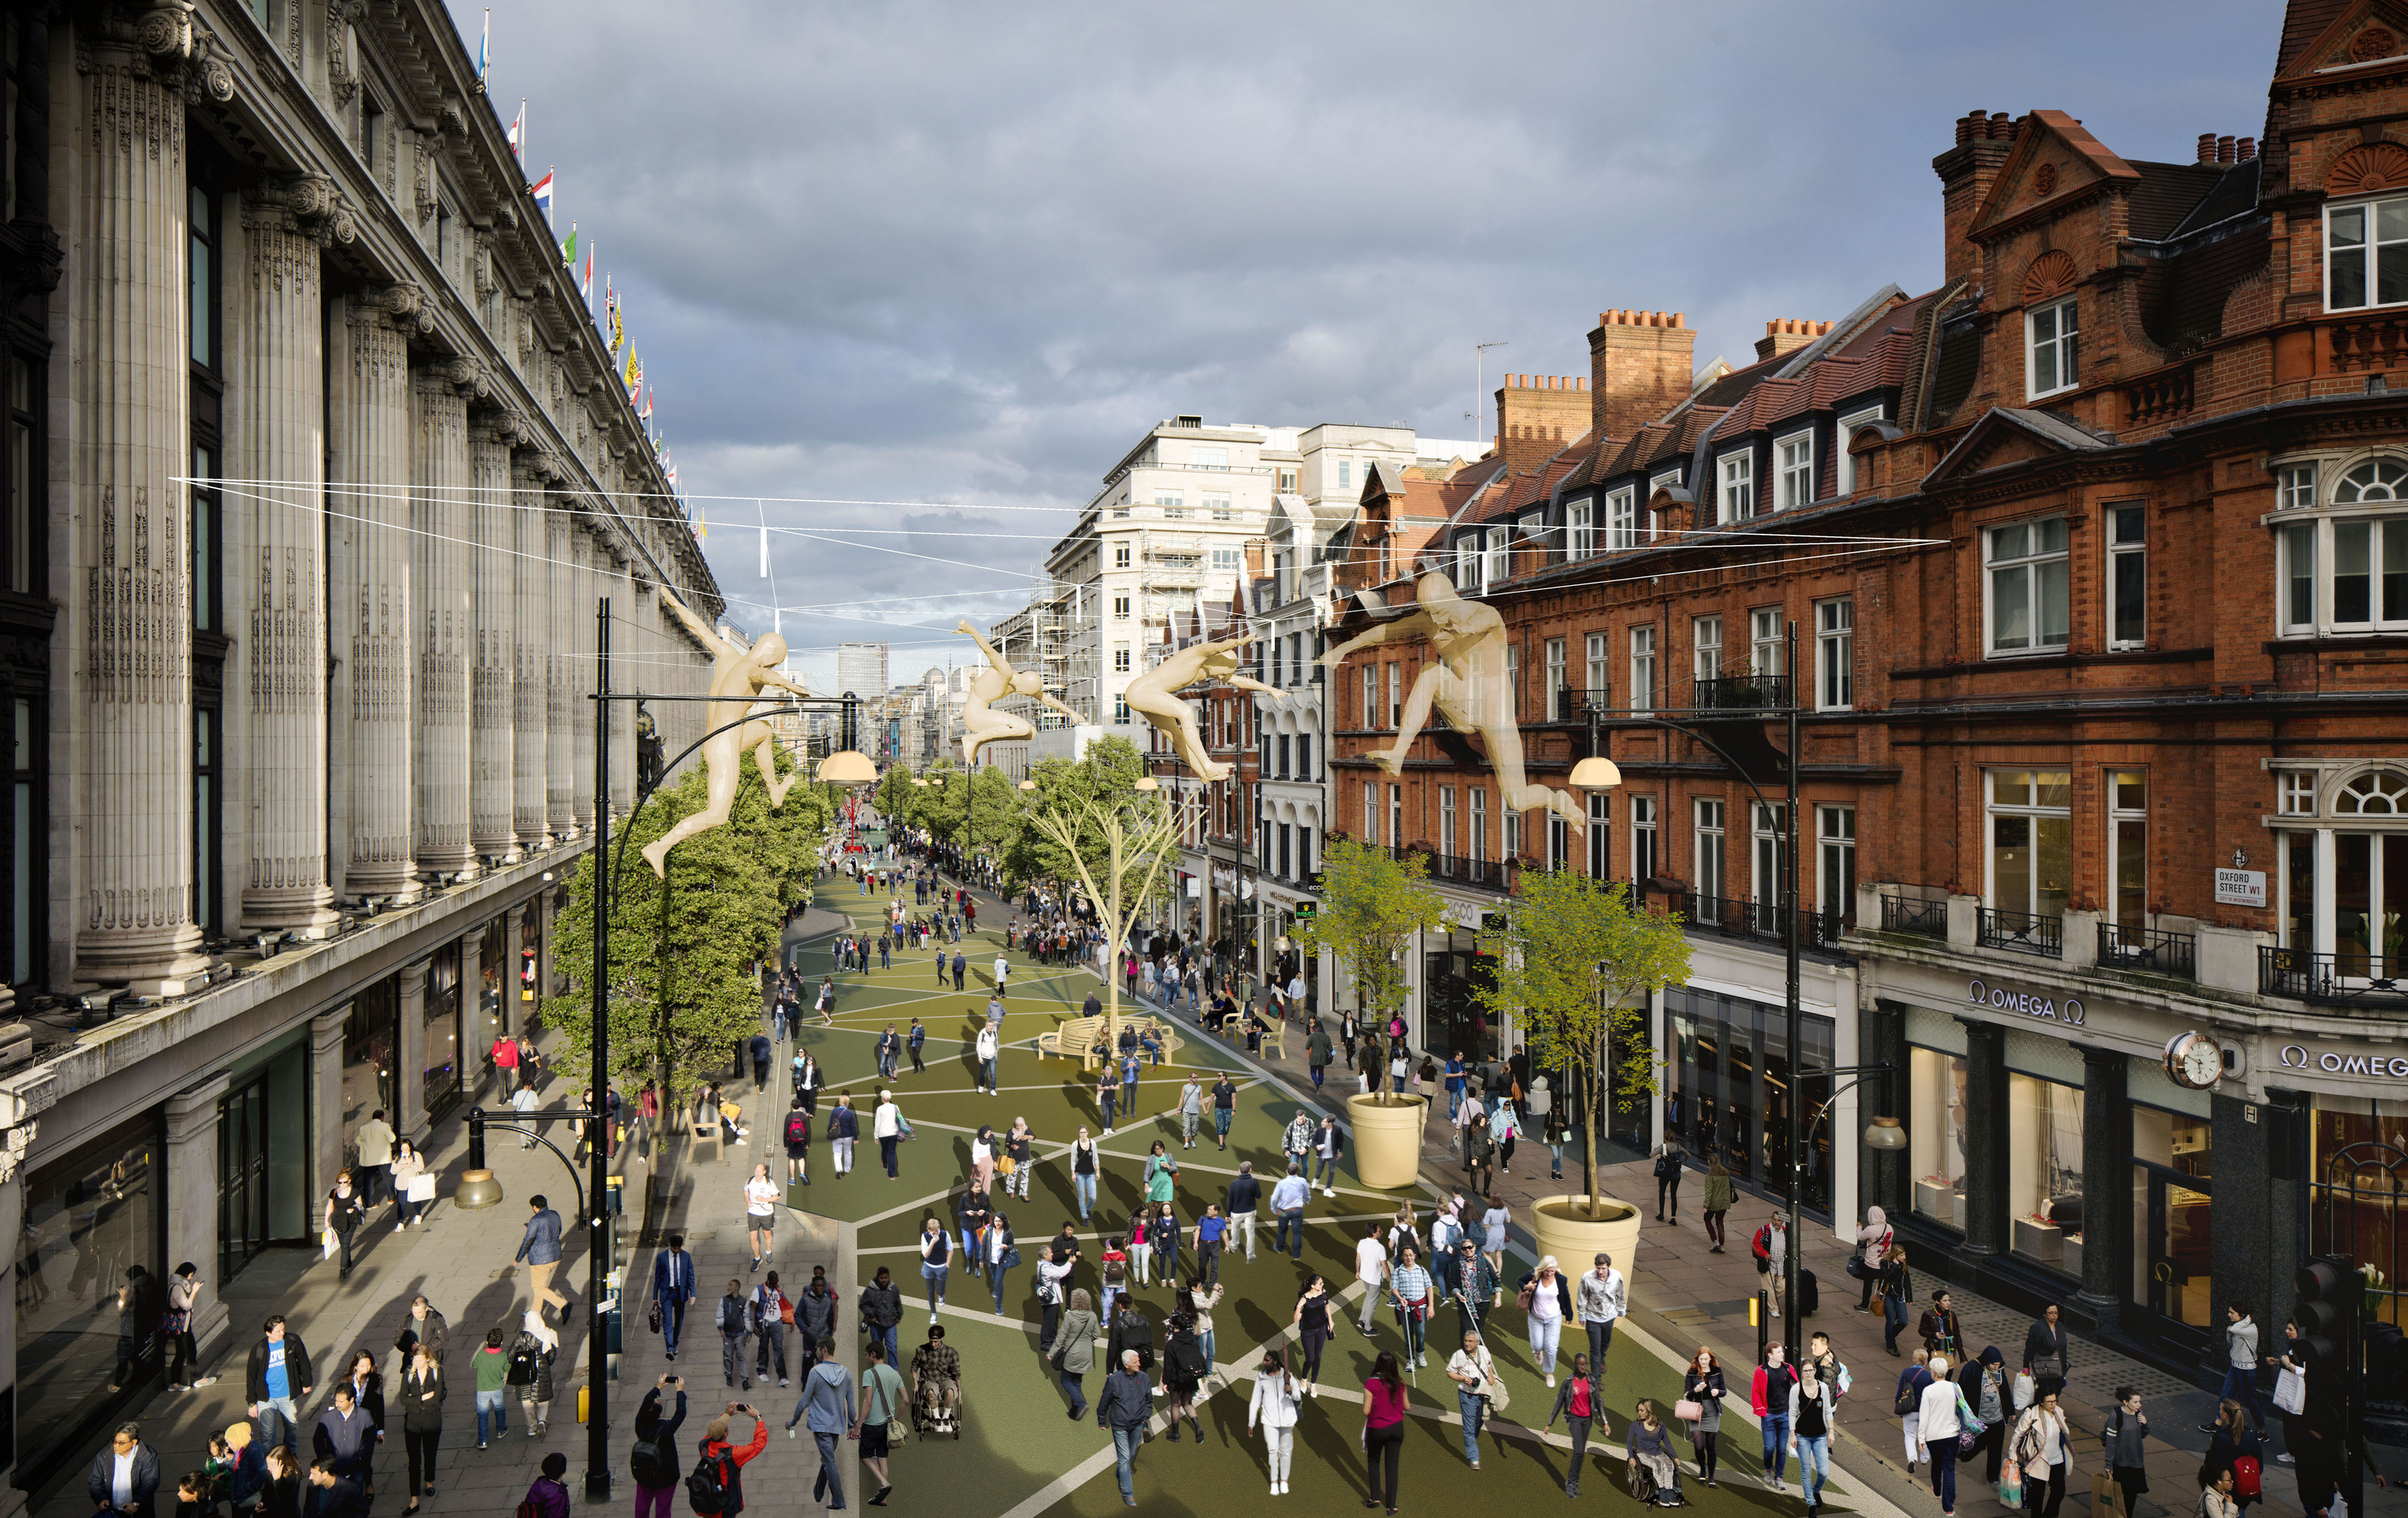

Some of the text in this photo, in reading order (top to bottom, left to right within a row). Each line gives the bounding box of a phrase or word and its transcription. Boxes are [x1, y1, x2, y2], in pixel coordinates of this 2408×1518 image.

[2219, 872, 2249, 883] OXFORD
[2219, 882, 2260, 895] STREET W1
[1991, 989, 2056, 1019] OMEGA
[2321, 1052, 2408, 1076] OMEG
